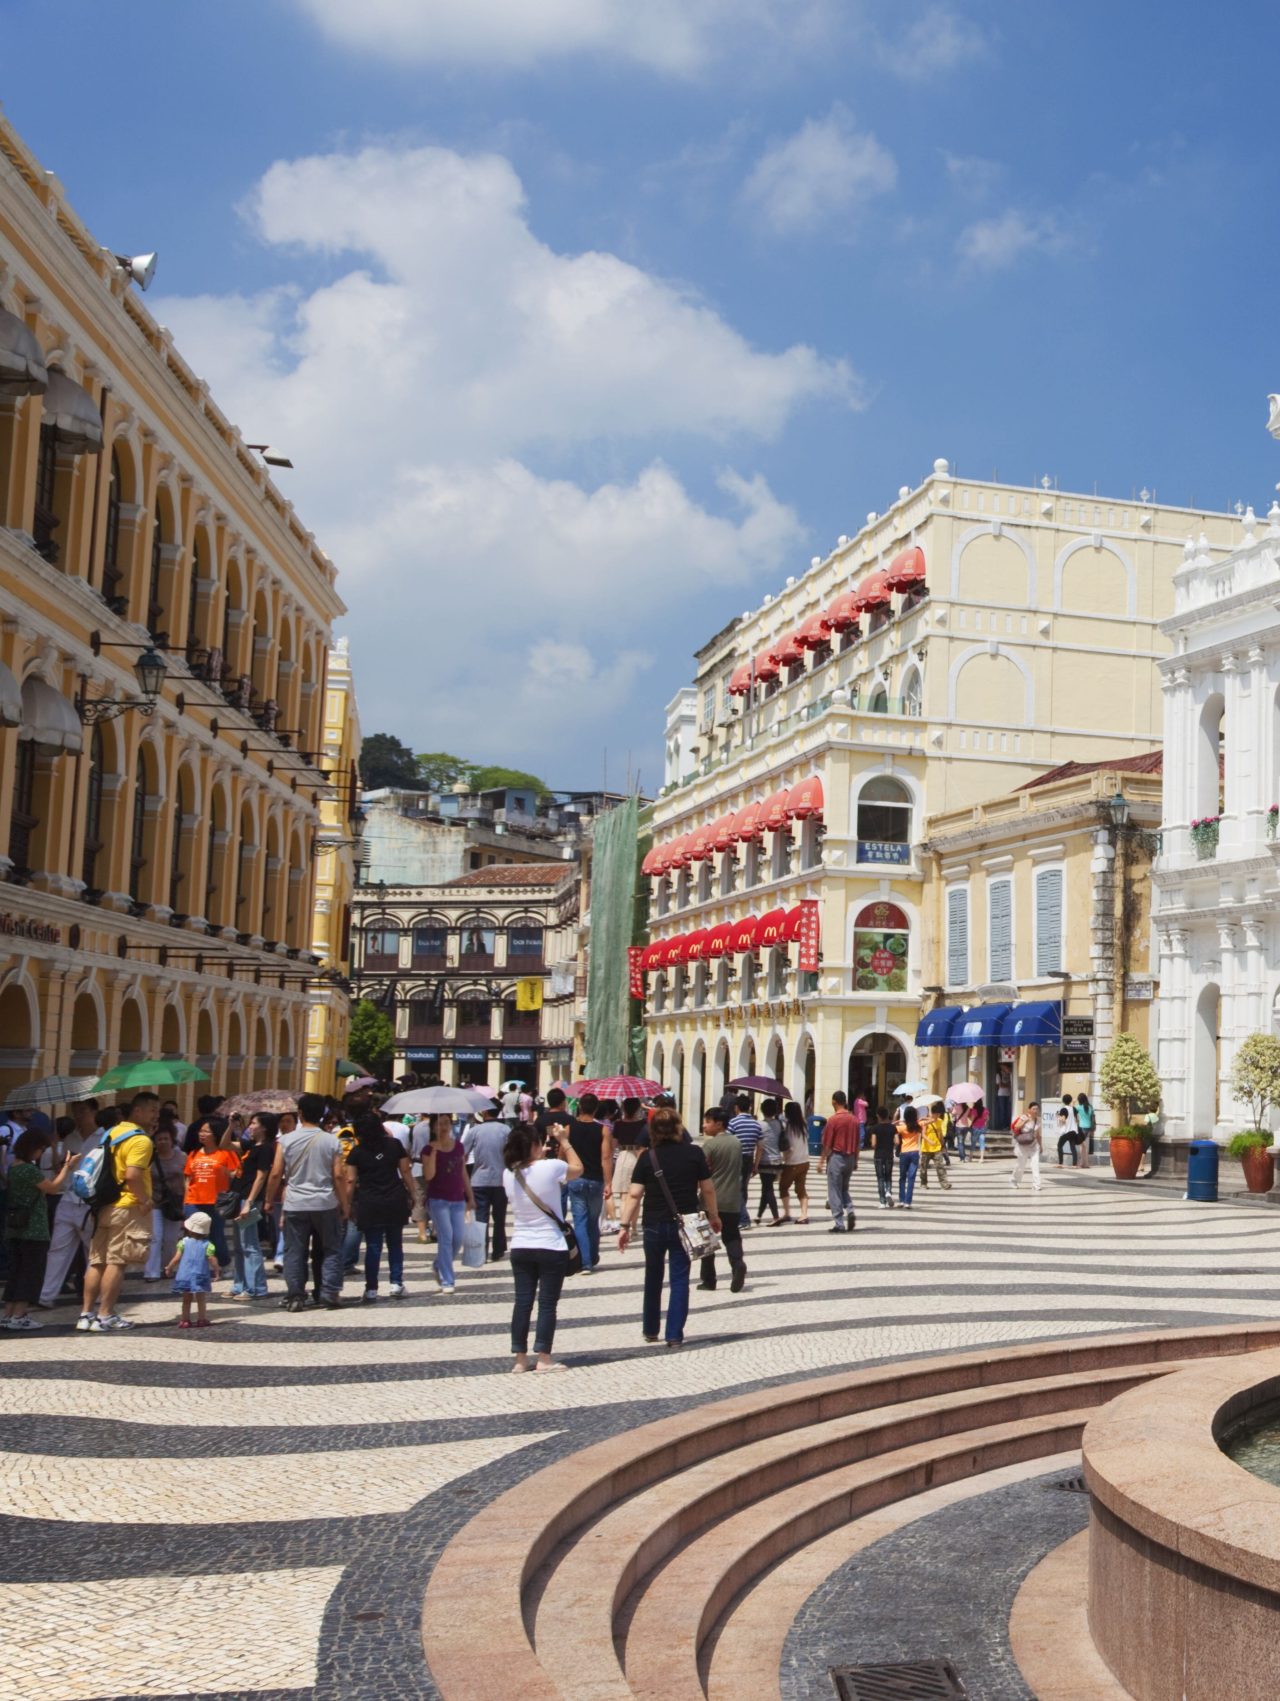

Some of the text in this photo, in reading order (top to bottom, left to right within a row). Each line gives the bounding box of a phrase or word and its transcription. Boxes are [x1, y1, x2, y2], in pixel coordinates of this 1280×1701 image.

[865, 843, 902, 852] ESTELA
[28, 918, 61, 945] Centre
[407, 1051, 435, 1059] bauhaus
[455, 1052, 483, 1060] bauhaus
